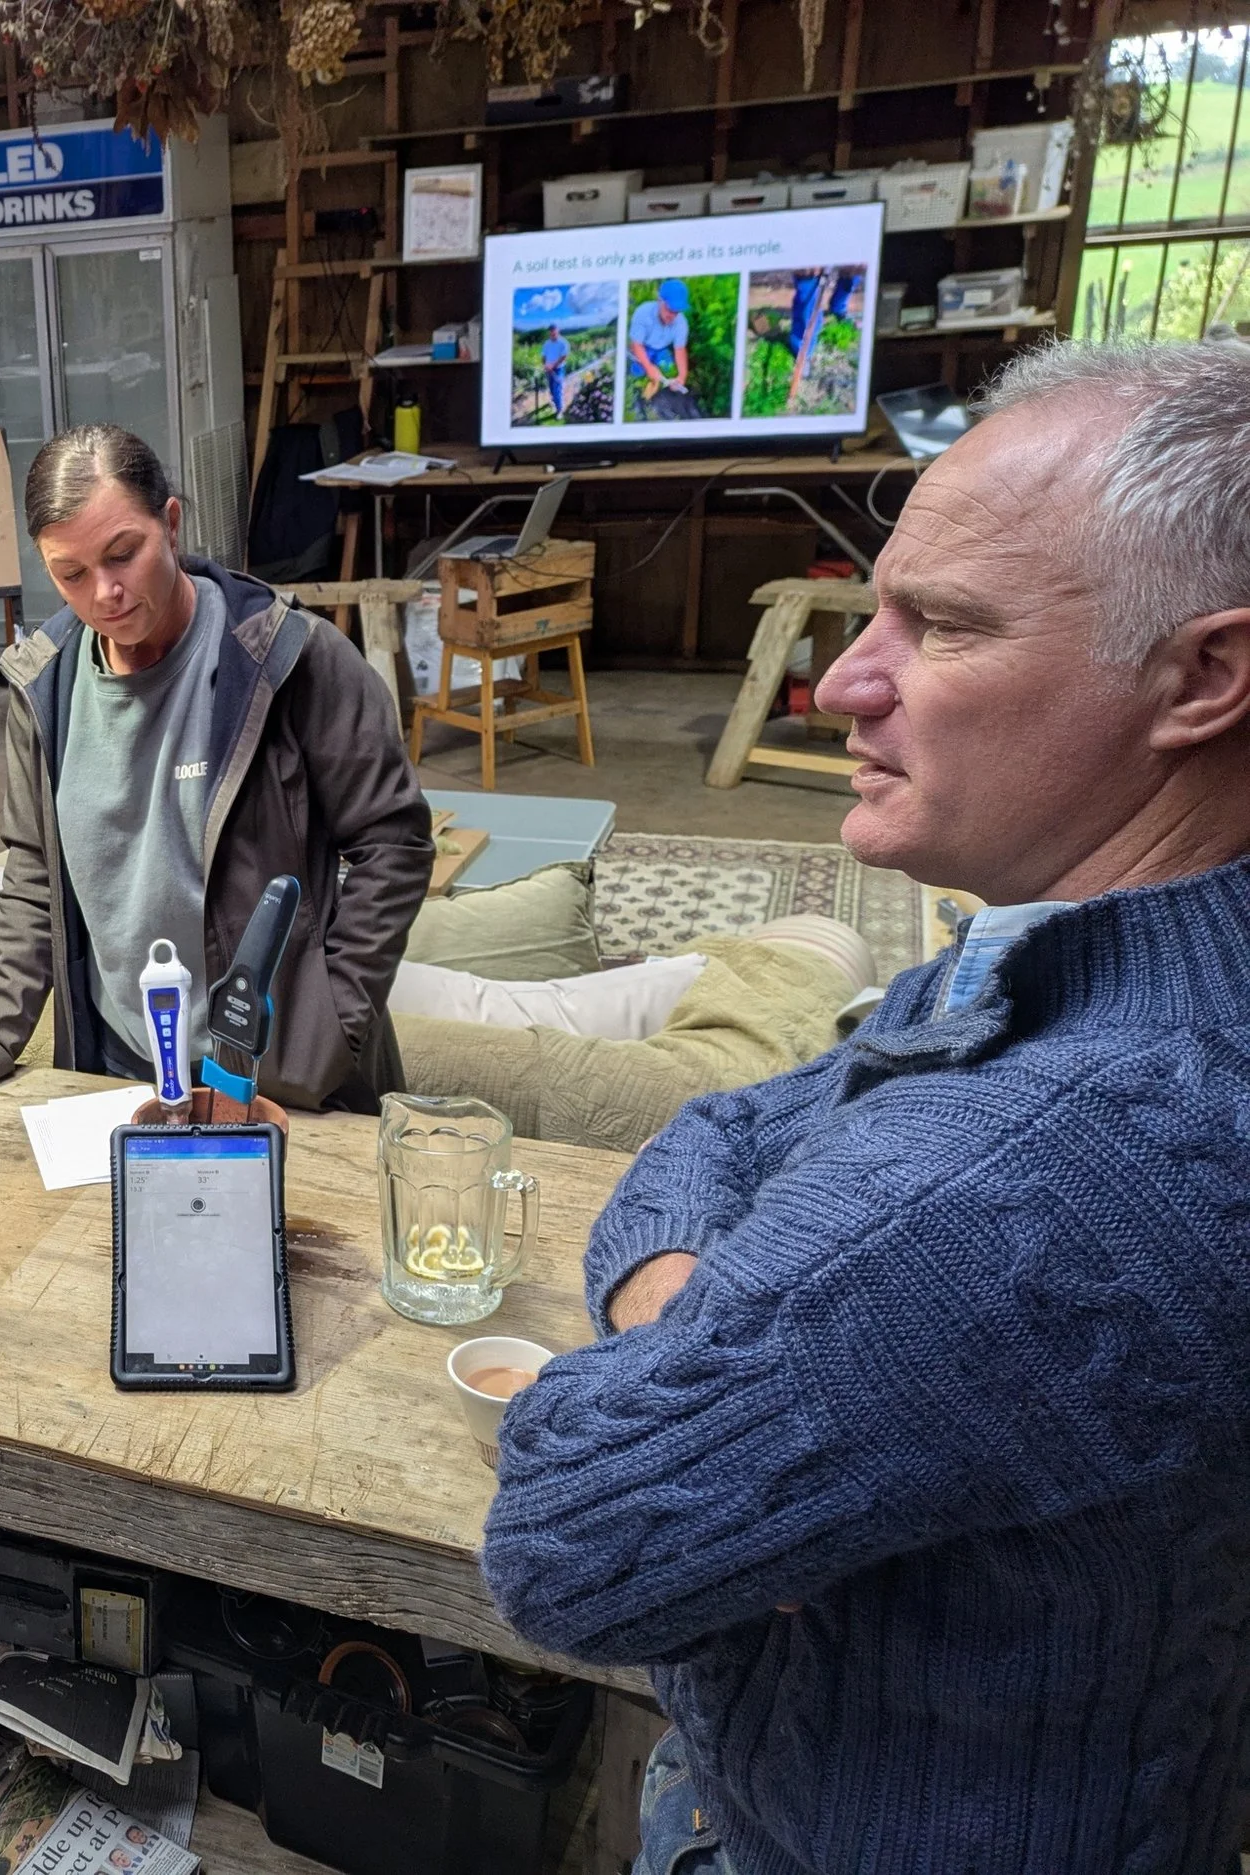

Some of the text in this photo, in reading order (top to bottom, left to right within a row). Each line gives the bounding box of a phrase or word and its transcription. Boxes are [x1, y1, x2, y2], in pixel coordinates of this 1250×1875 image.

[513, 260, 523, 273] A
[526, 257, 548, 272] soil
[553, 256, 578, 270] test
[582, 254, 592, 268] is
[596, 250, 626, 269] only
[629, 252, 644, 264] as
[648, 246, 684, 266] good
[688, 247, 703, 261] as
[707, 243, 726, 259] its
[82, 1667, 117, 1685] erald
[66, 1810, 94, 1838] up
[90, 1827, 111, 1851] at
